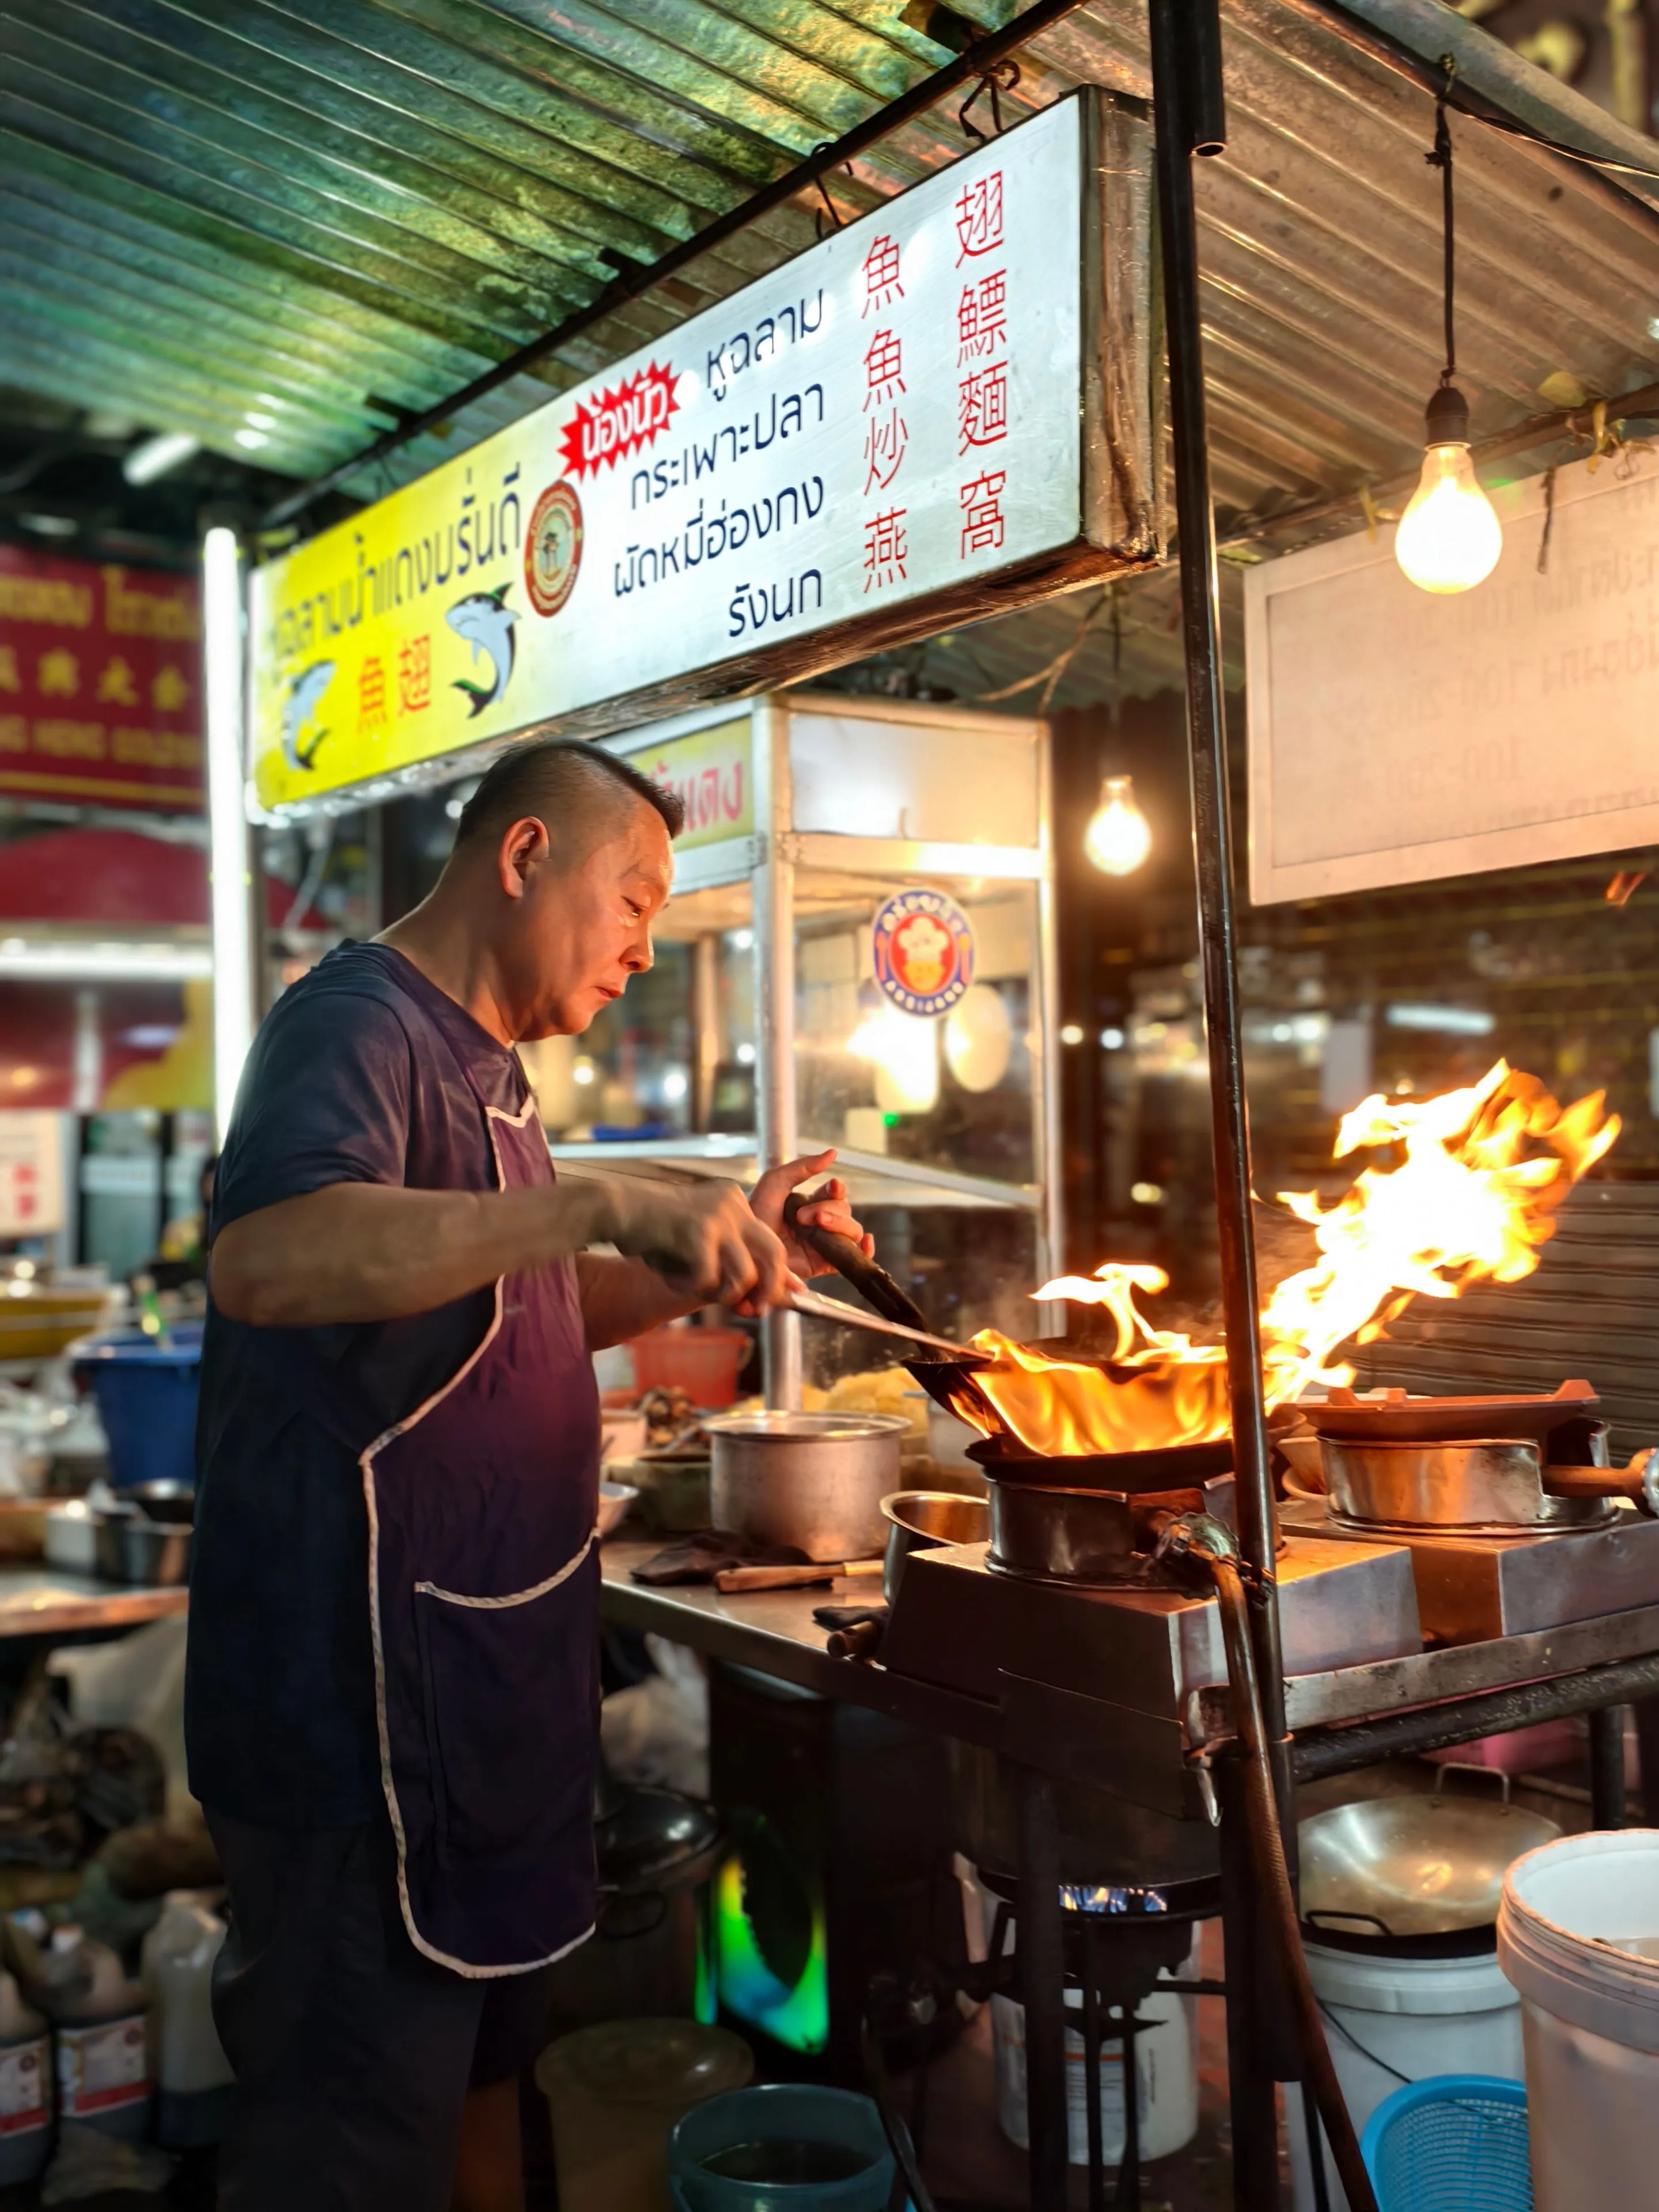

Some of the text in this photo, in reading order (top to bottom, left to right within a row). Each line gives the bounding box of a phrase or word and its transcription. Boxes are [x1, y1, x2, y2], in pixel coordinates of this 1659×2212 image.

[707, 289, 823, 402] หูฉลาม
[632, 383, 823, 510] กระเพาะปลา
[615, 476, 824, 597] ผัดหมี่ฮ่องกง
[729, 569, 821, 637] รังนก
